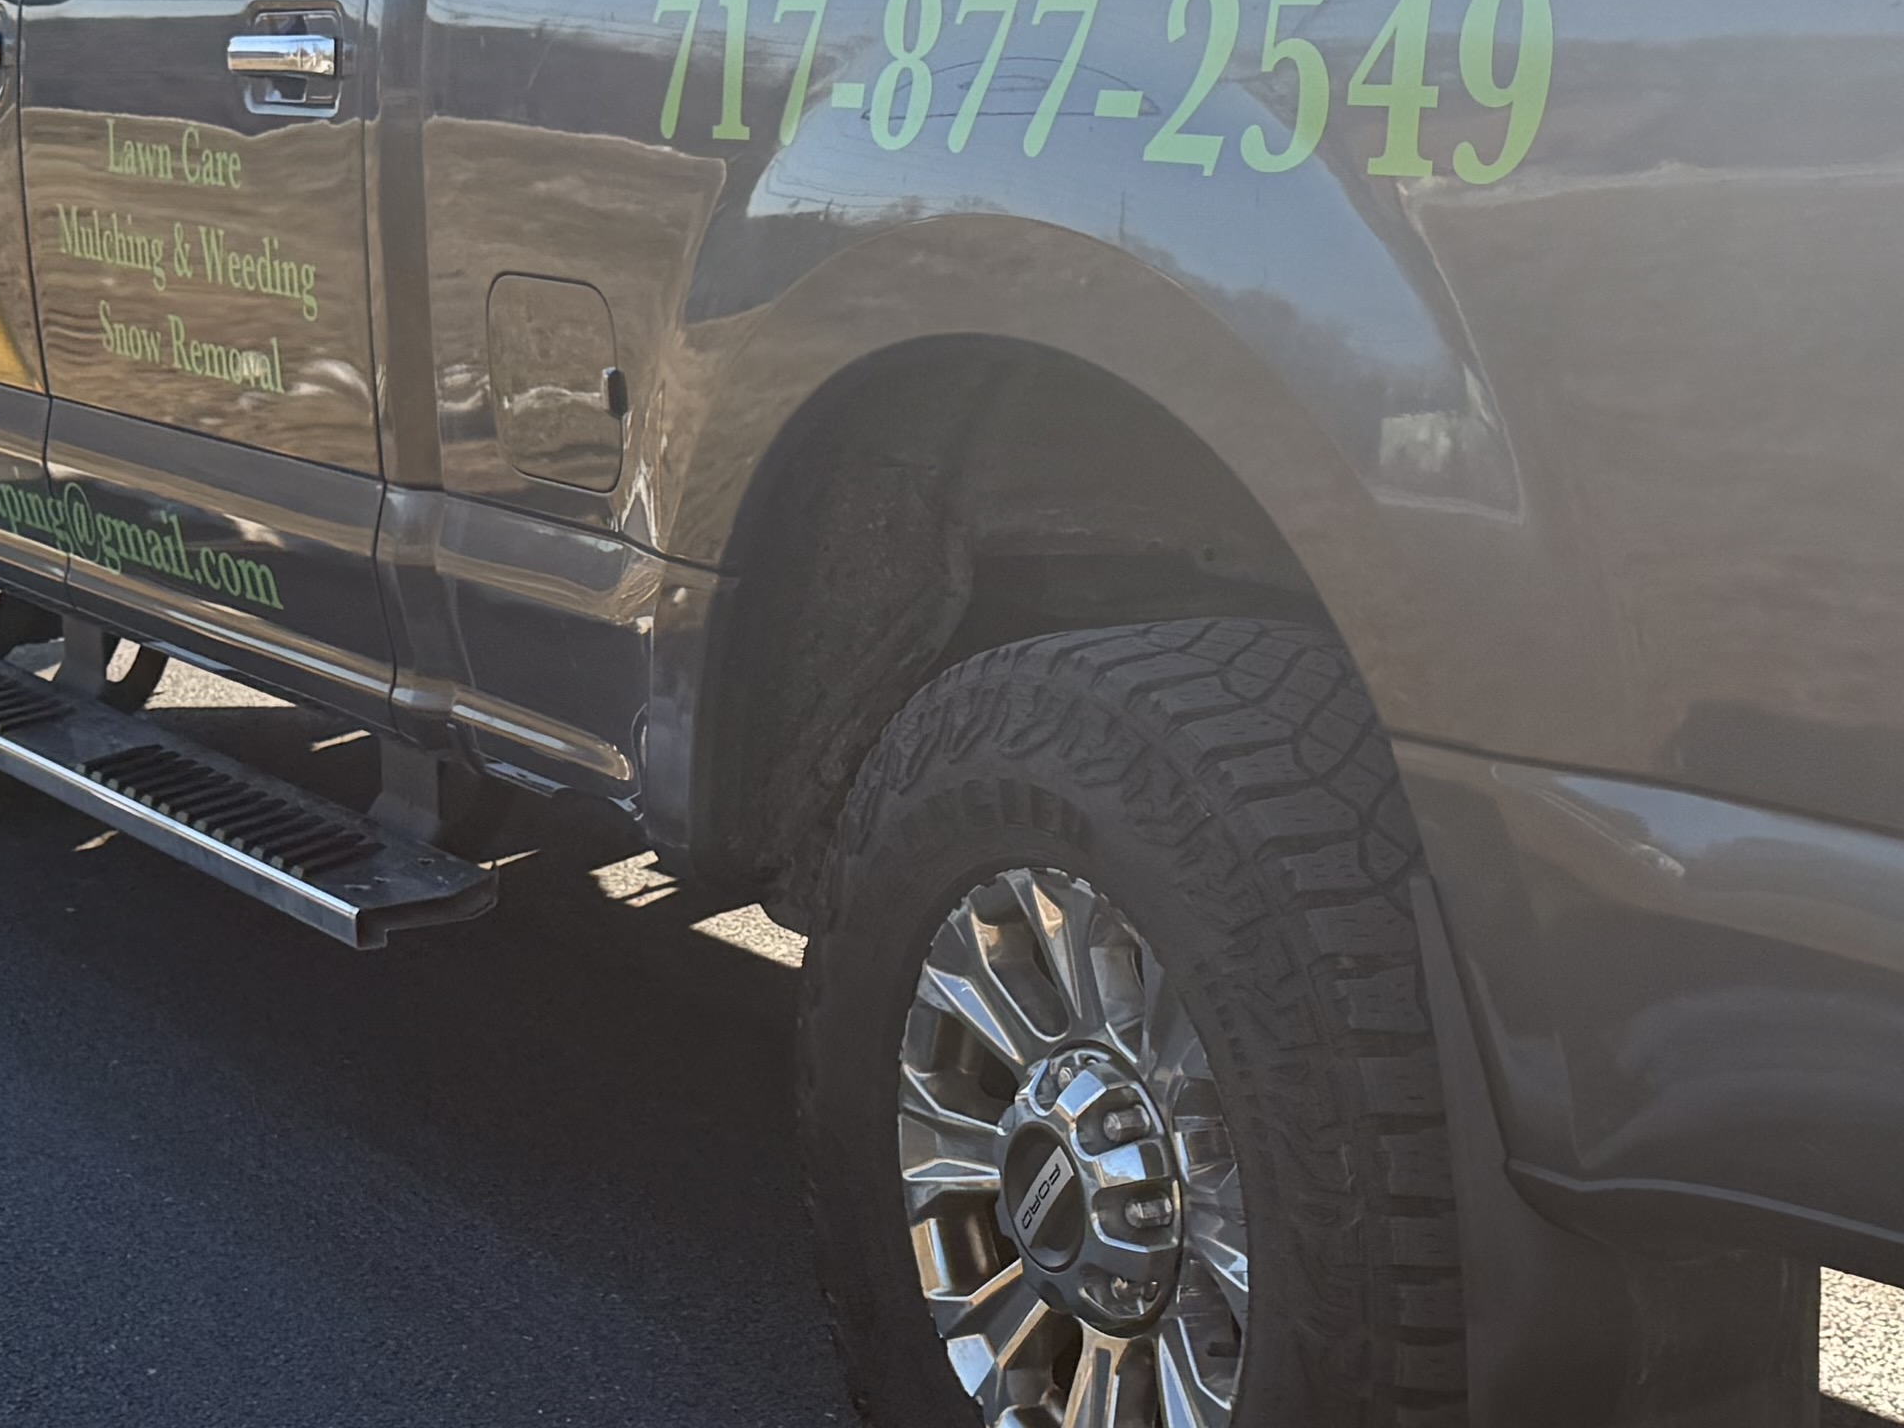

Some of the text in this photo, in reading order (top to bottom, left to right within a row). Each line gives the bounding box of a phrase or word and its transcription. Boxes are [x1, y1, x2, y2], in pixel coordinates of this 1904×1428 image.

[105, 118, 243, 189] Lawn Care
[56, 203, 169, 292] Mulching
[173, 223, 193, 279] &
[198, 227, 319, 321] Weeding
[98, 300, 286, 394] Snow Removal
[1021, 1163, 1061, 1229] FORD
